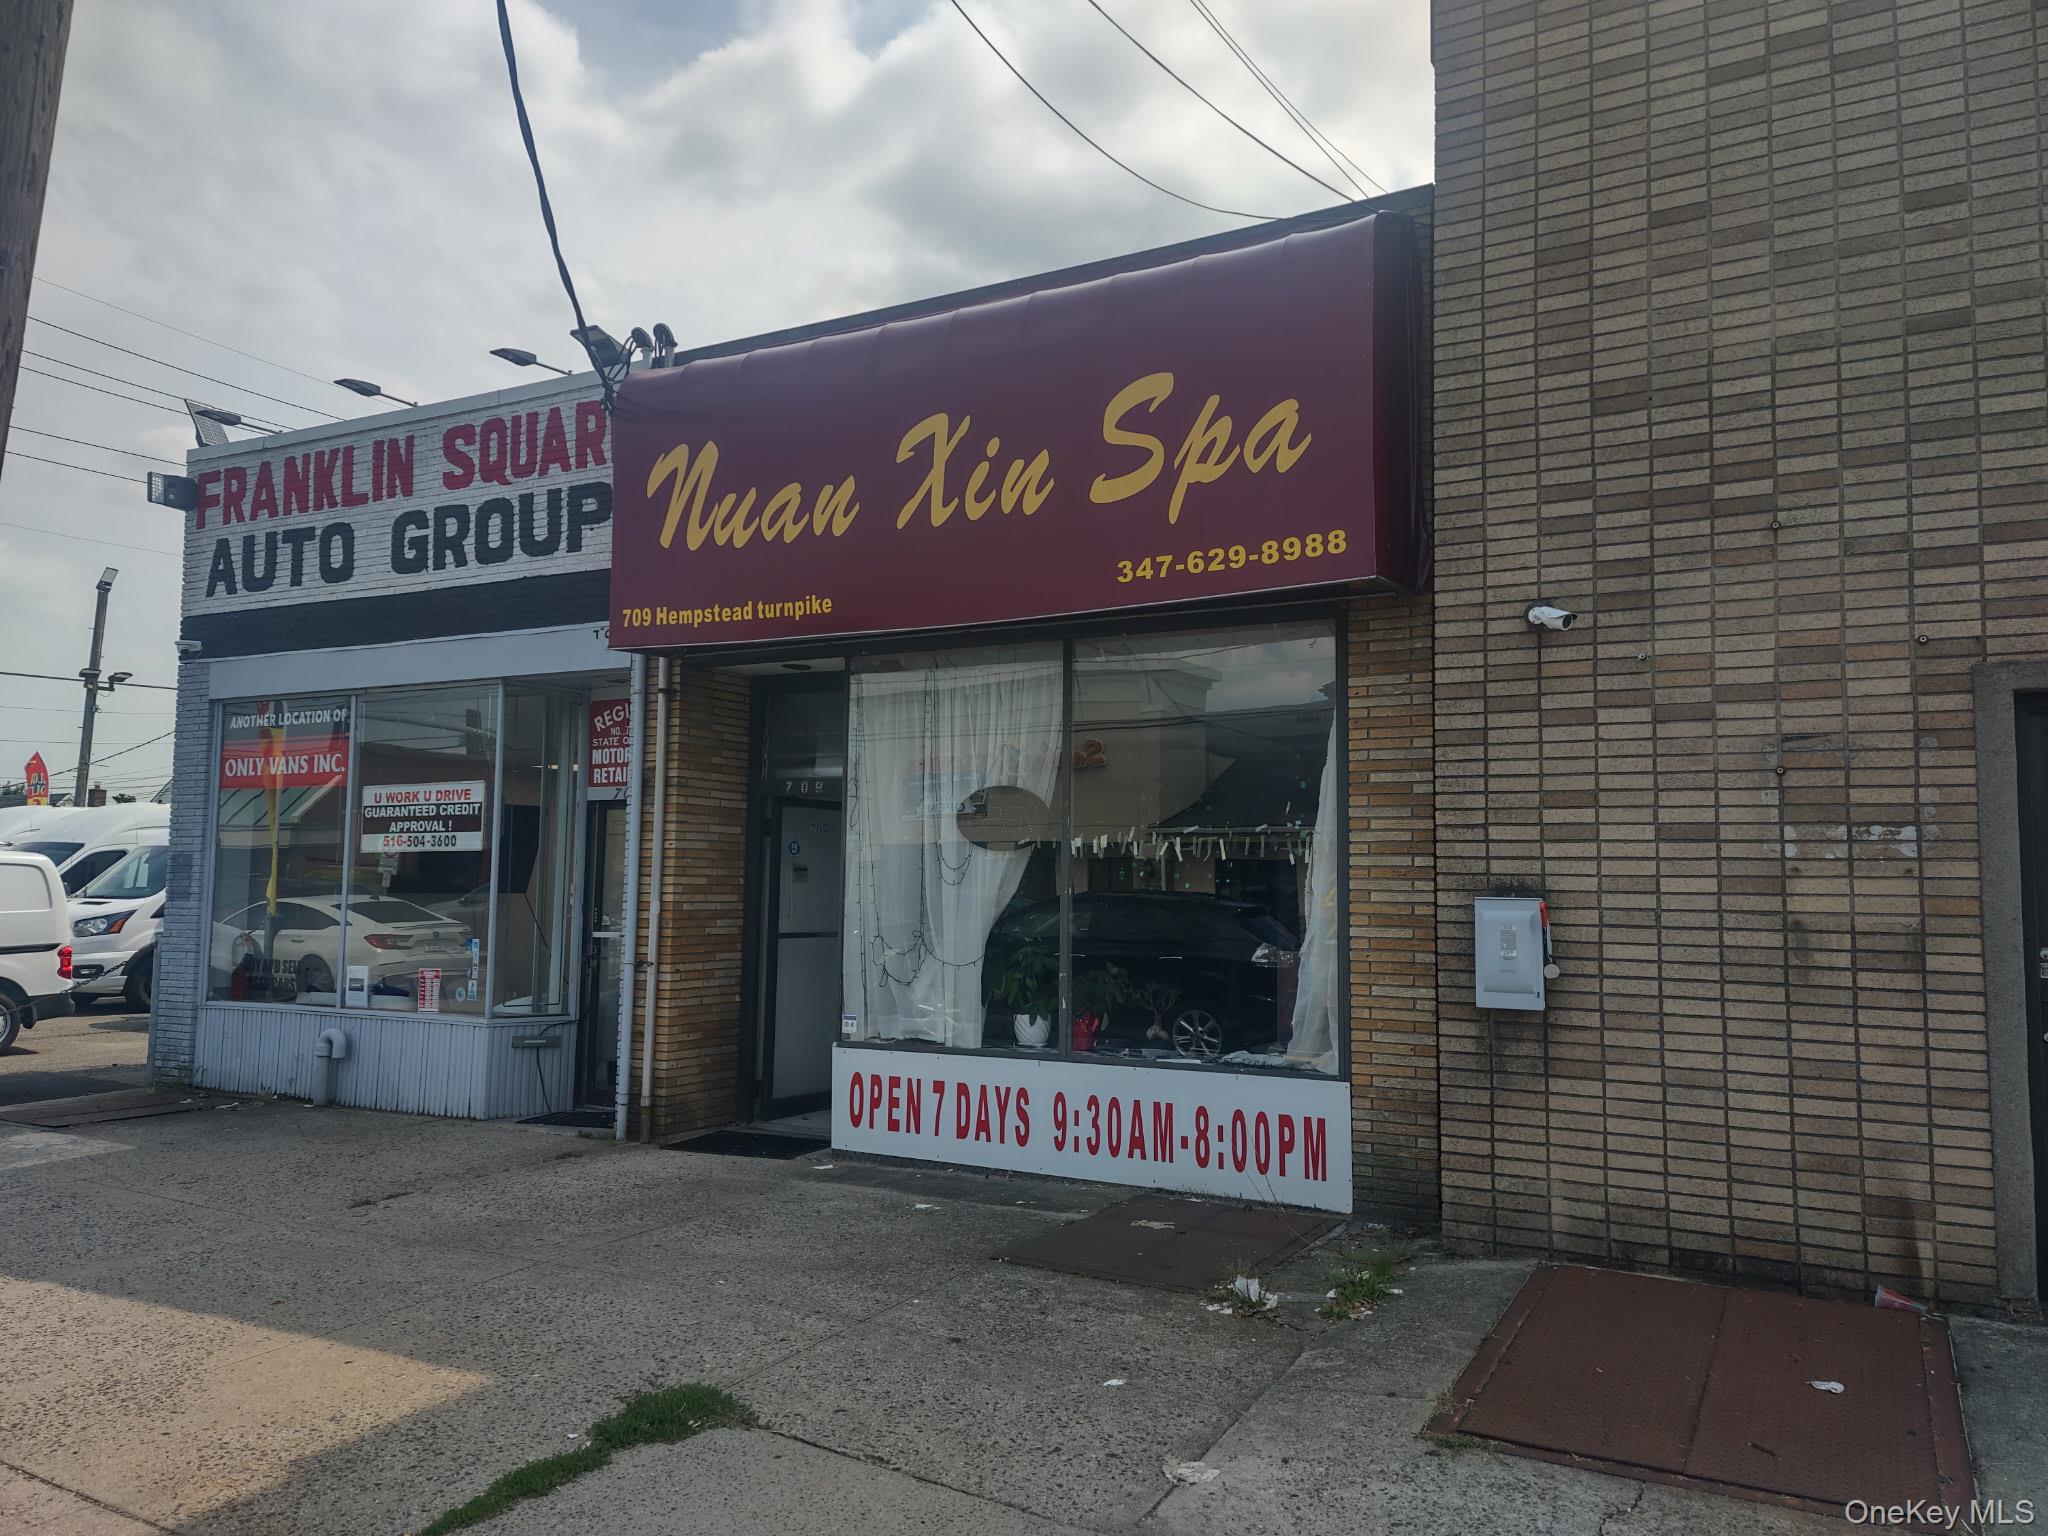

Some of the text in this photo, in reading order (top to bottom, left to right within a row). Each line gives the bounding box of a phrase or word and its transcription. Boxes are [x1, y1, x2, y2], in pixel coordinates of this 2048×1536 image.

[647, 371, 1313, 551] Nuan Xin Spa
[195, 435, 415, 529] FRANKLIN
[205, 481, 613, 598] AUTO GROUP
[1116, 528, 1348, 585] 347-629-8988
[622, 594, 833, 630] 709 Hempstead turnpike
[229, 708, 348, 729] ANOTHER LOCATION OF
[592, 737, 620, 747] STATE
[225, 753, 346, 777] ONLY VANS INC.
[374, 788, 472, 804] U WORK U DRIVE
[364, 803, 481, 818] GUARANTEED CREDIT
[388, 819, 446, 833] APPROVAL
[383, 834, 457, 848] 516-504-3600
[848, 1071, 1328, 1182] OPEN 7 DAYS 9:30AM-8:00PM
